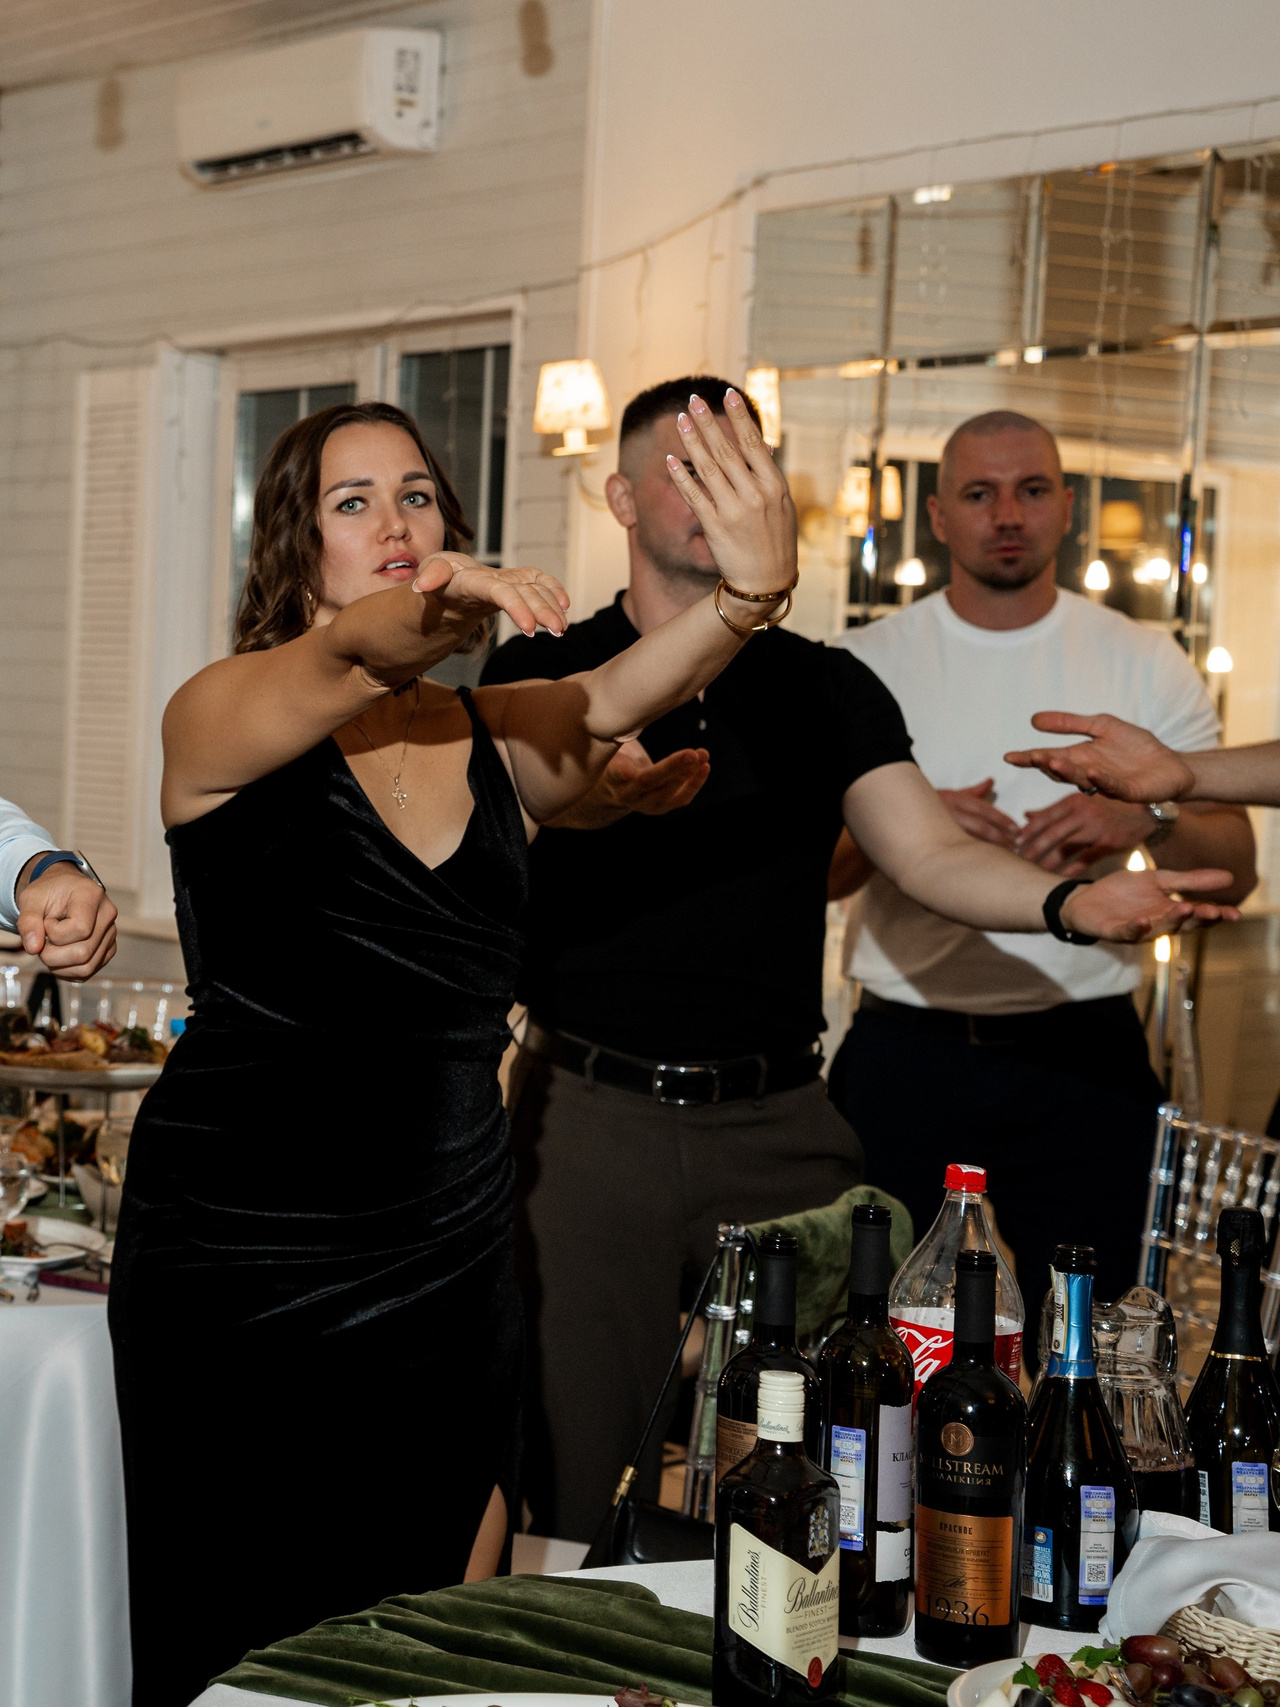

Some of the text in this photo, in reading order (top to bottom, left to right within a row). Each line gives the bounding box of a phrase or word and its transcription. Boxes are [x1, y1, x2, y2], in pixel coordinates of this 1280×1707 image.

[892, 1451, 913, 1462] КЛАС
[919, 1452, 1004, 1476] LLSTREAM
[931, 1472, 992, 1486] ОЛЛЕКЦИЯ
[939, 1522, 973, 1535] КРАСНОЕ
[737, 1549, 760, 1633] Ballantine's
[804, 1605, 828, 1620] FINEST
[925, 1594, 990, 1626] 1936
